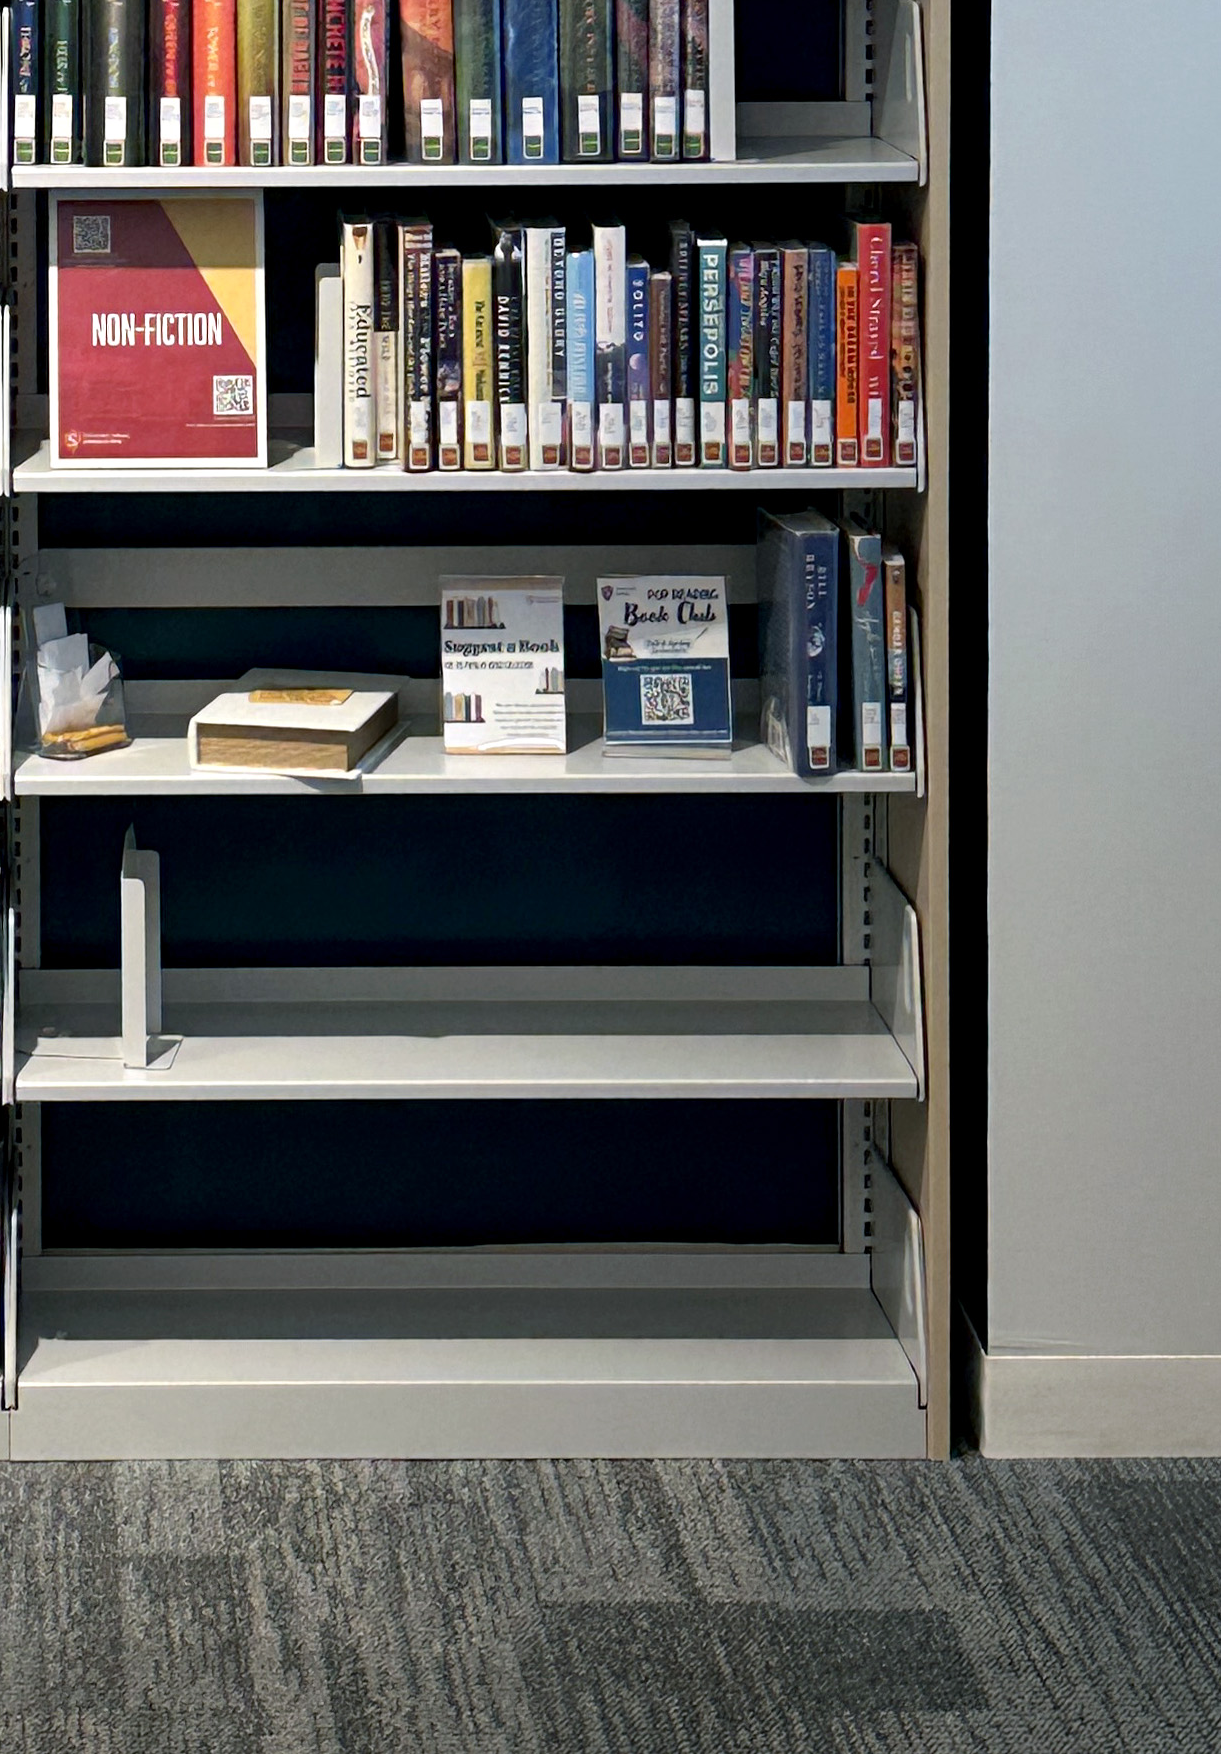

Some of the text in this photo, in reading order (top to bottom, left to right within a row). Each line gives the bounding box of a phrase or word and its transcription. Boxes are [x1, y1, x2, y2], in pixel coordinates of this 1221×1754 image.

[91, 312, 223, 347] NON-FICTION
[498, 296, 509, 337] DAVID
[555, 308, 565, 357] GLORY
[703, 254, 718, 395] PERSEPOLIS
[356, 304, 371, 398] Educated
[624, 600, 716, 626] Book Club
[444, 639, 560, 657] Suggest a Book
